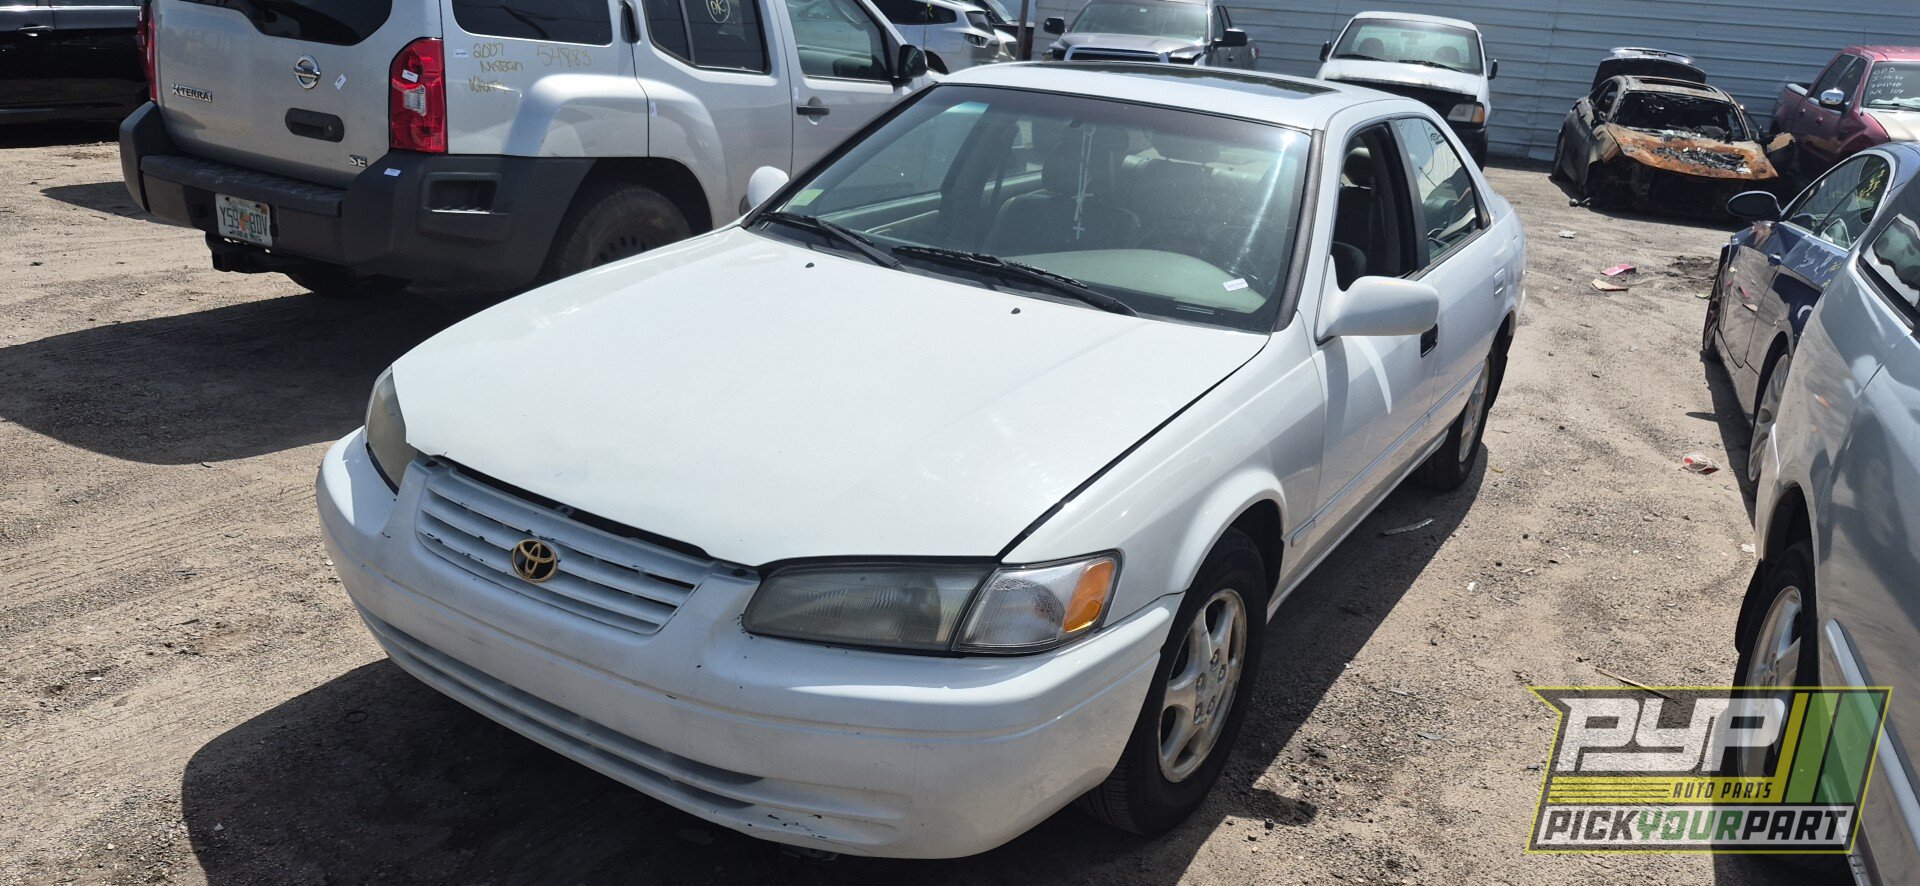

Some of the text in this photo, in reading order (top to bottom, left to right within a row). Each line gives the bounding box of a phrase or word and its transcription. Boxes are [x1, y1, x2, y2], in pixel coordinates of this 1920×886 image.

[473, 42, 504, 59] 2007
[171, 83, 212, 102] XTERRA
[349, 154, 368, 168] SE
